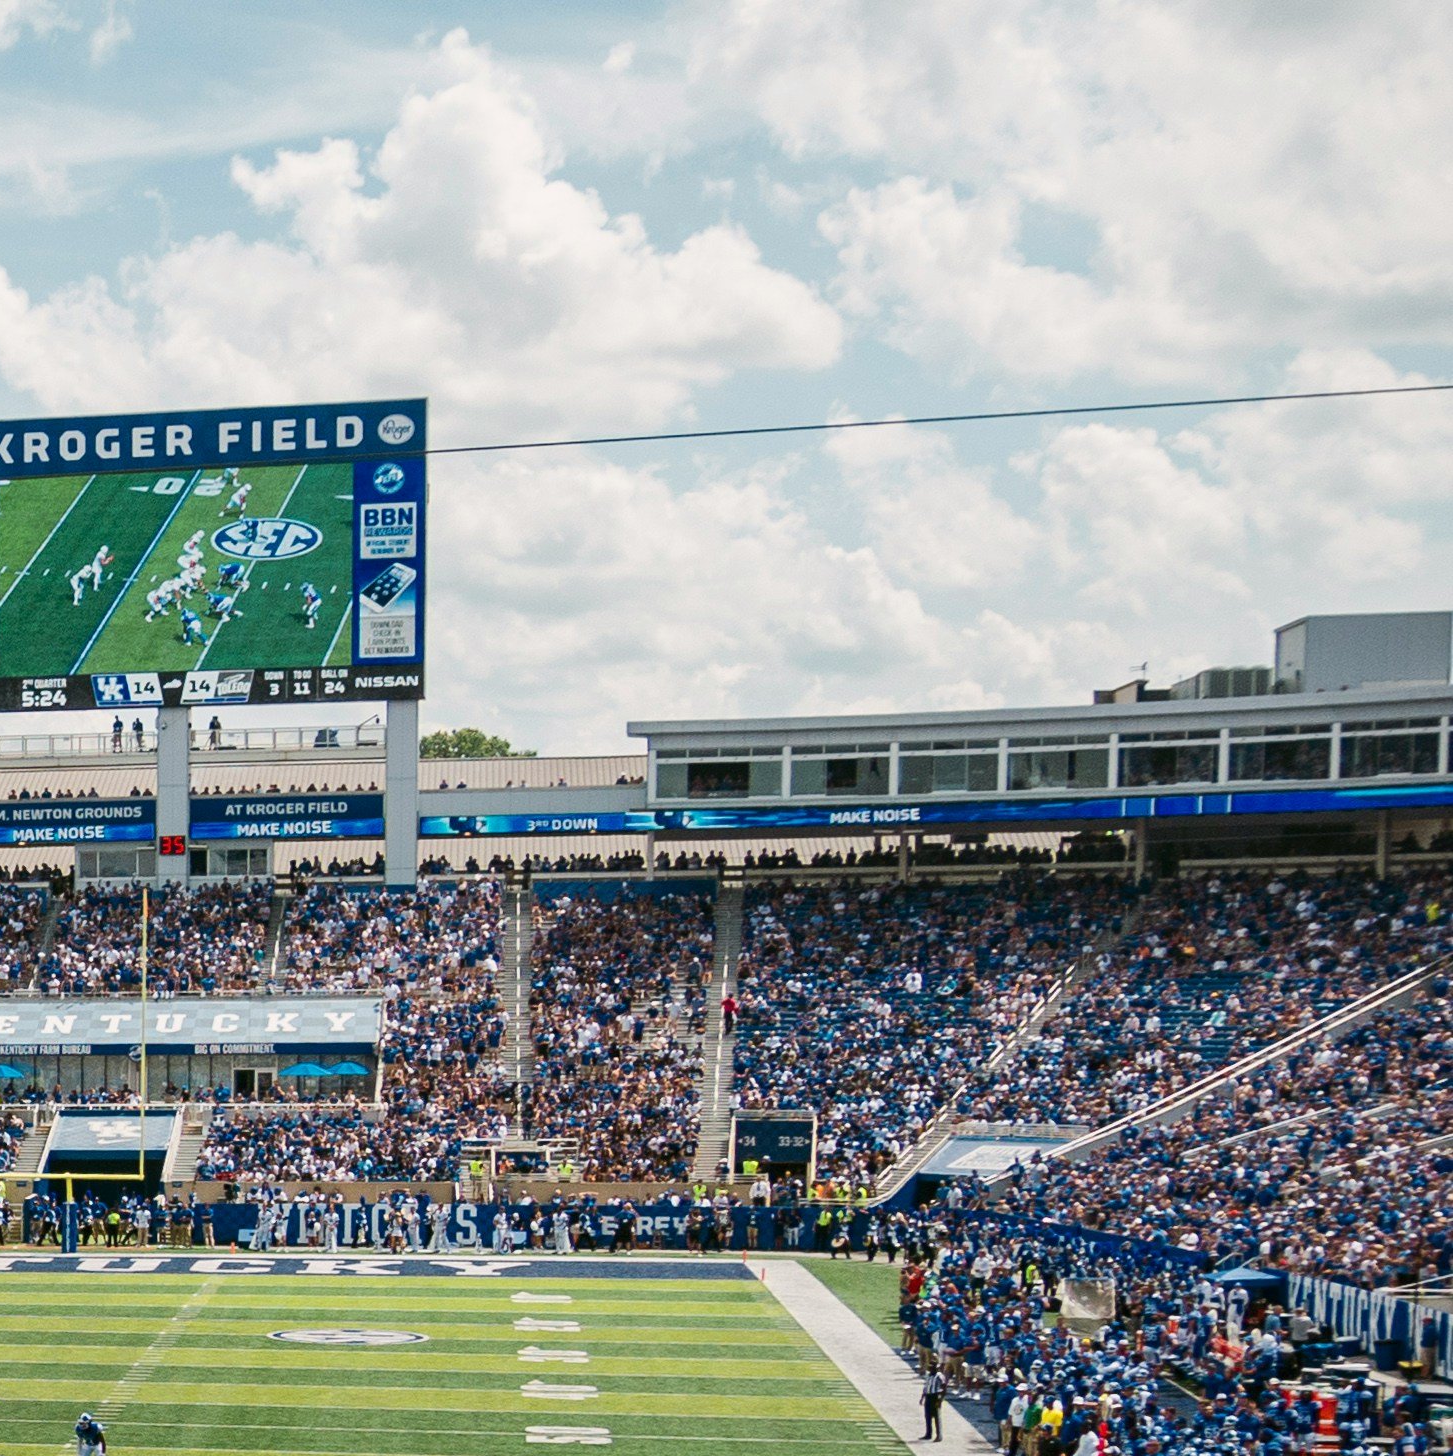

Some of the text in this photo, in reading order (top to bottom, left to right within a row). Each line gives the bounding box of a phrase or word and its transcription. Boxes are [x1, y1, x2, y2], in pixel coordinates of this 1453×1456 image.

[218, 415, 364, 454] FIELD
[364, 507, 413, 527] BBN
[134, 681, 155, 695] 14
[189, 679, 210, 692] 14
[293, 682, 311, 695] 11
[324, 681, 346, 694] 24
[354, 675, 419, 688] NISSAN
[269, 683, 280, 696] 3
[21, 690, 68, 707] 5:24
[13, 806, 72, 821] NEWTON
[75, 804, 143, 819] GROUNDS
[225, 800, 348, 816] AT KROGER FIELD
[829, 808, 921, 824] MAKE NOISE
[237, 821, 332, 838] MAKE NOISE
[552, 817, 599, 831] DOWN
[12, 825, 105, 842] MAKE NOISE
[162, 837, 185, 854] 35
[0, 1044, 91, 1055] KENTUCKY FARM BUREAU
[743, 1136, 757, 1147] 34
